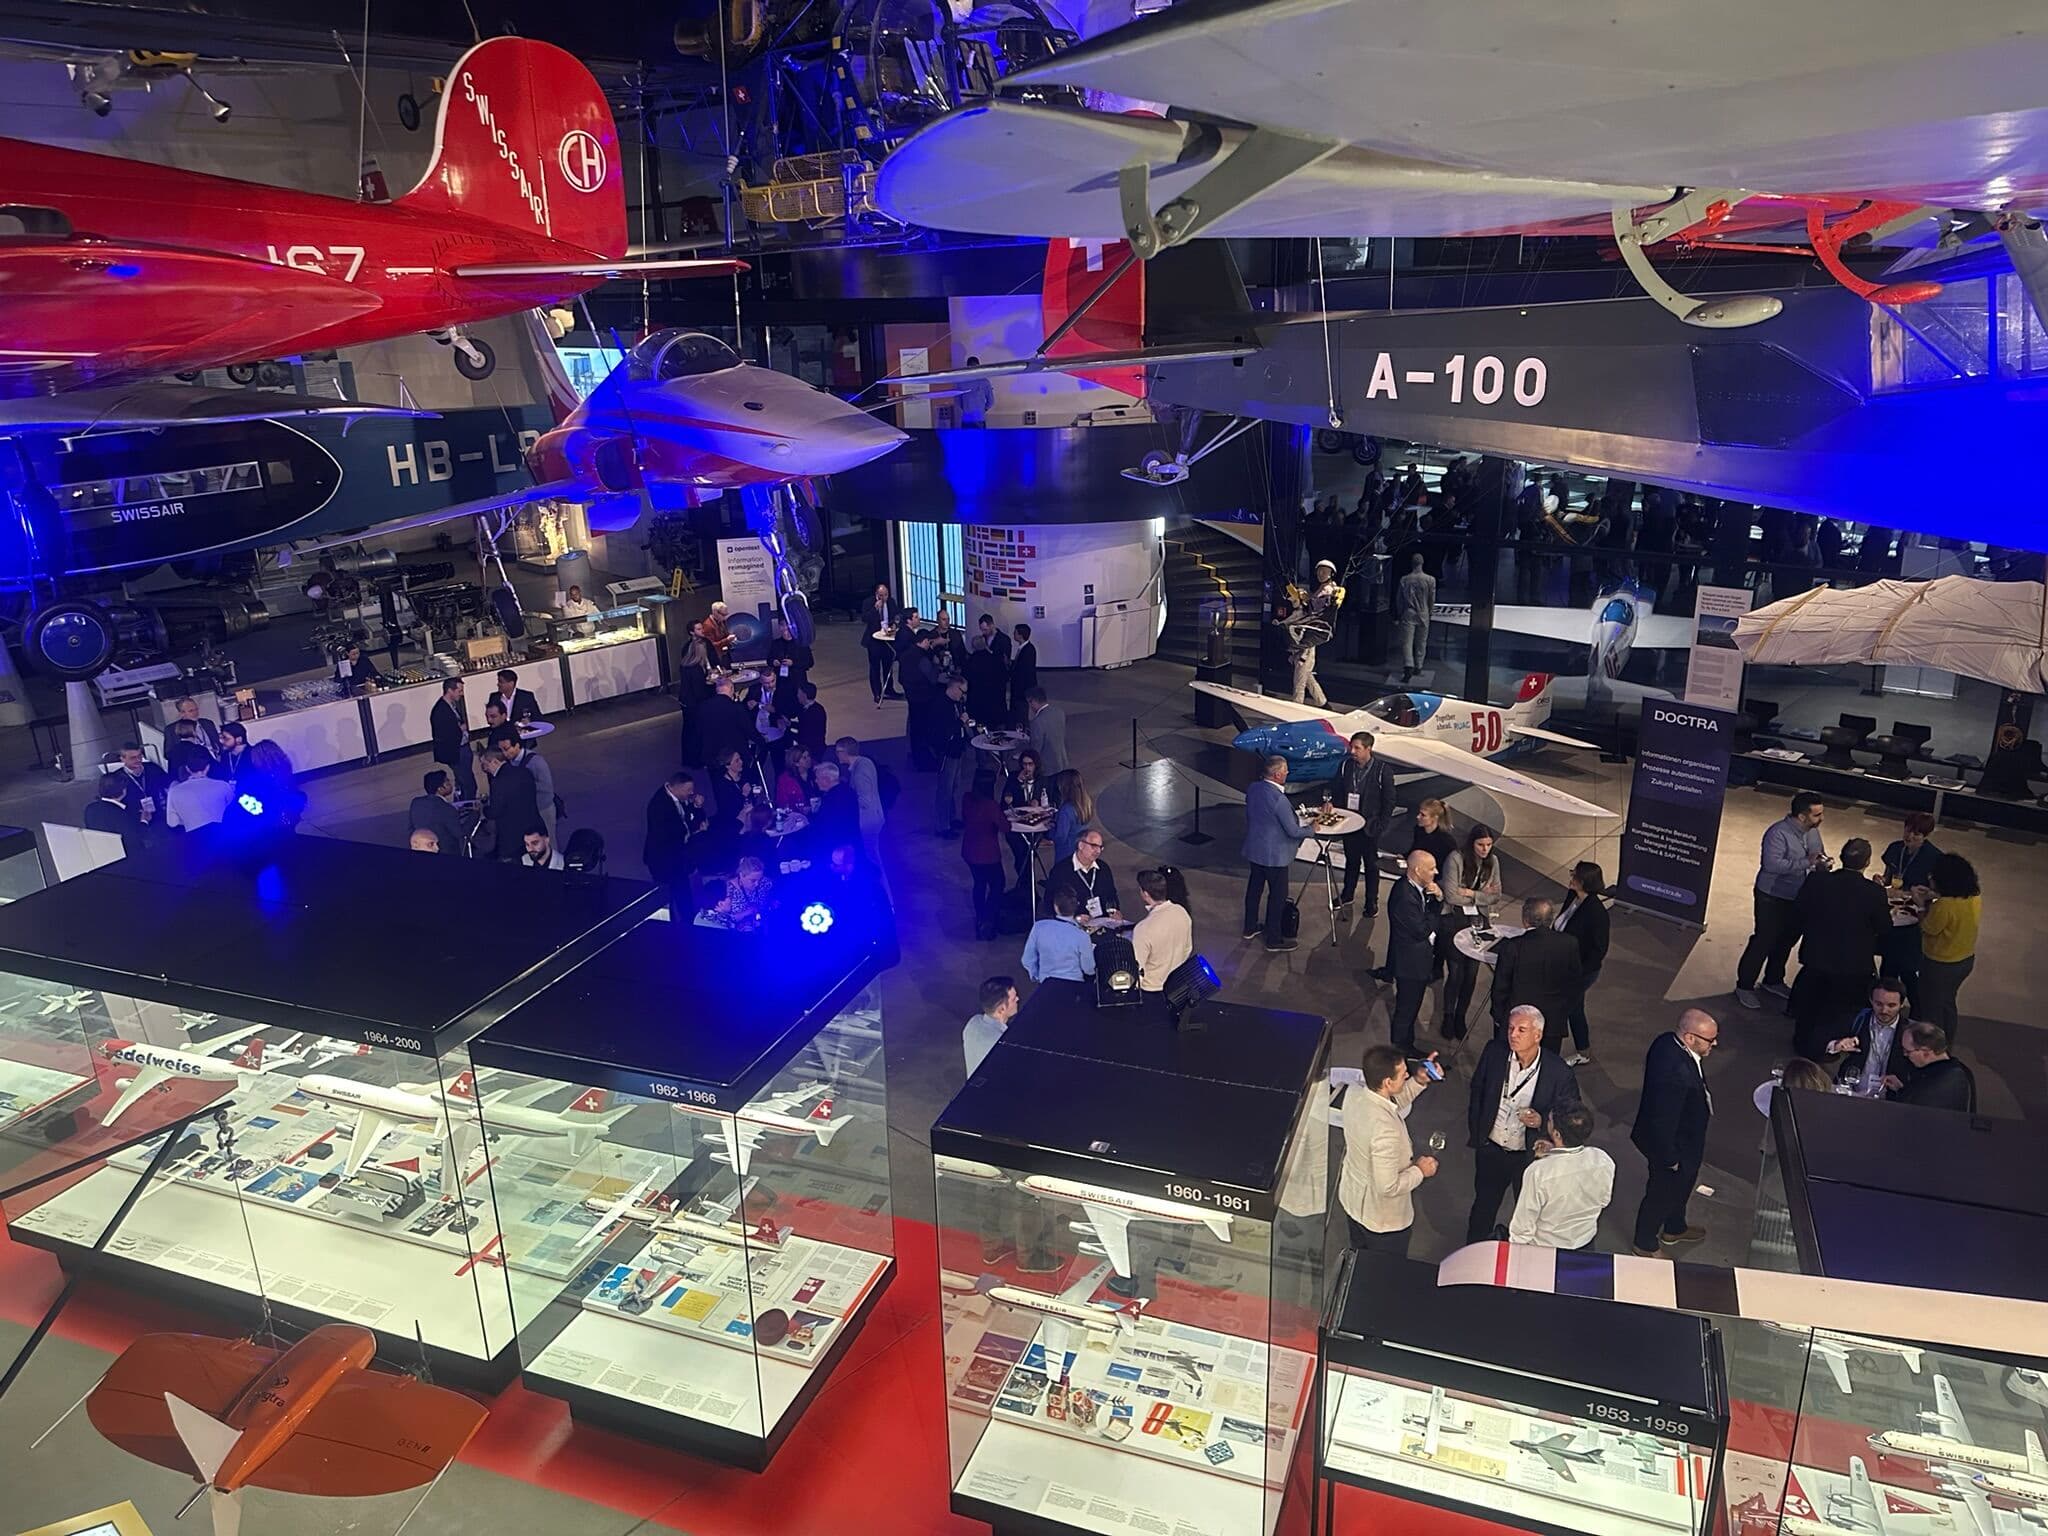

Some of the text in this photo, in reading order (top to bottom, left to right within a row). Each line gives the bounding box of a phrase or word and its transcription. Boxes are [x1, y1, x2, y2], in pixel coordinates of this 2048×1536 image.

[463, 72, 545, 224] SWISSAIR
[1366, 352, 1547, 407] A-100
[110, 502, 185, 523] SWISSAIR
[1654, 710, 1719, 732] DOCTRA
[1471, 711, 1502, 753] 50
[1641, 750, 1721, 772] Informationen organisieren
[1642, 763, 1715, 784] Prozesse automatisieren
[1650, 778, 1703, 795] Zukunft gestalten
[1641, 822, 1697, 841] Strategische Beratung
[1633, 844, 1658, 855] OpenText
[1676, 855, 1700, 866] Expertise
[1643, 839, 1690, 855] Managed Services
[113, 1049, 201, 1075] edelweiss
[332, 1089, 361, 1099] SWISSAIR
[1080, 1189, 1133, 1206] SWISSAIR
[1030, 1301, 1067, 1312] SWISSAIR
[1938, 1451, 1990, 1464] SWISSAIR
